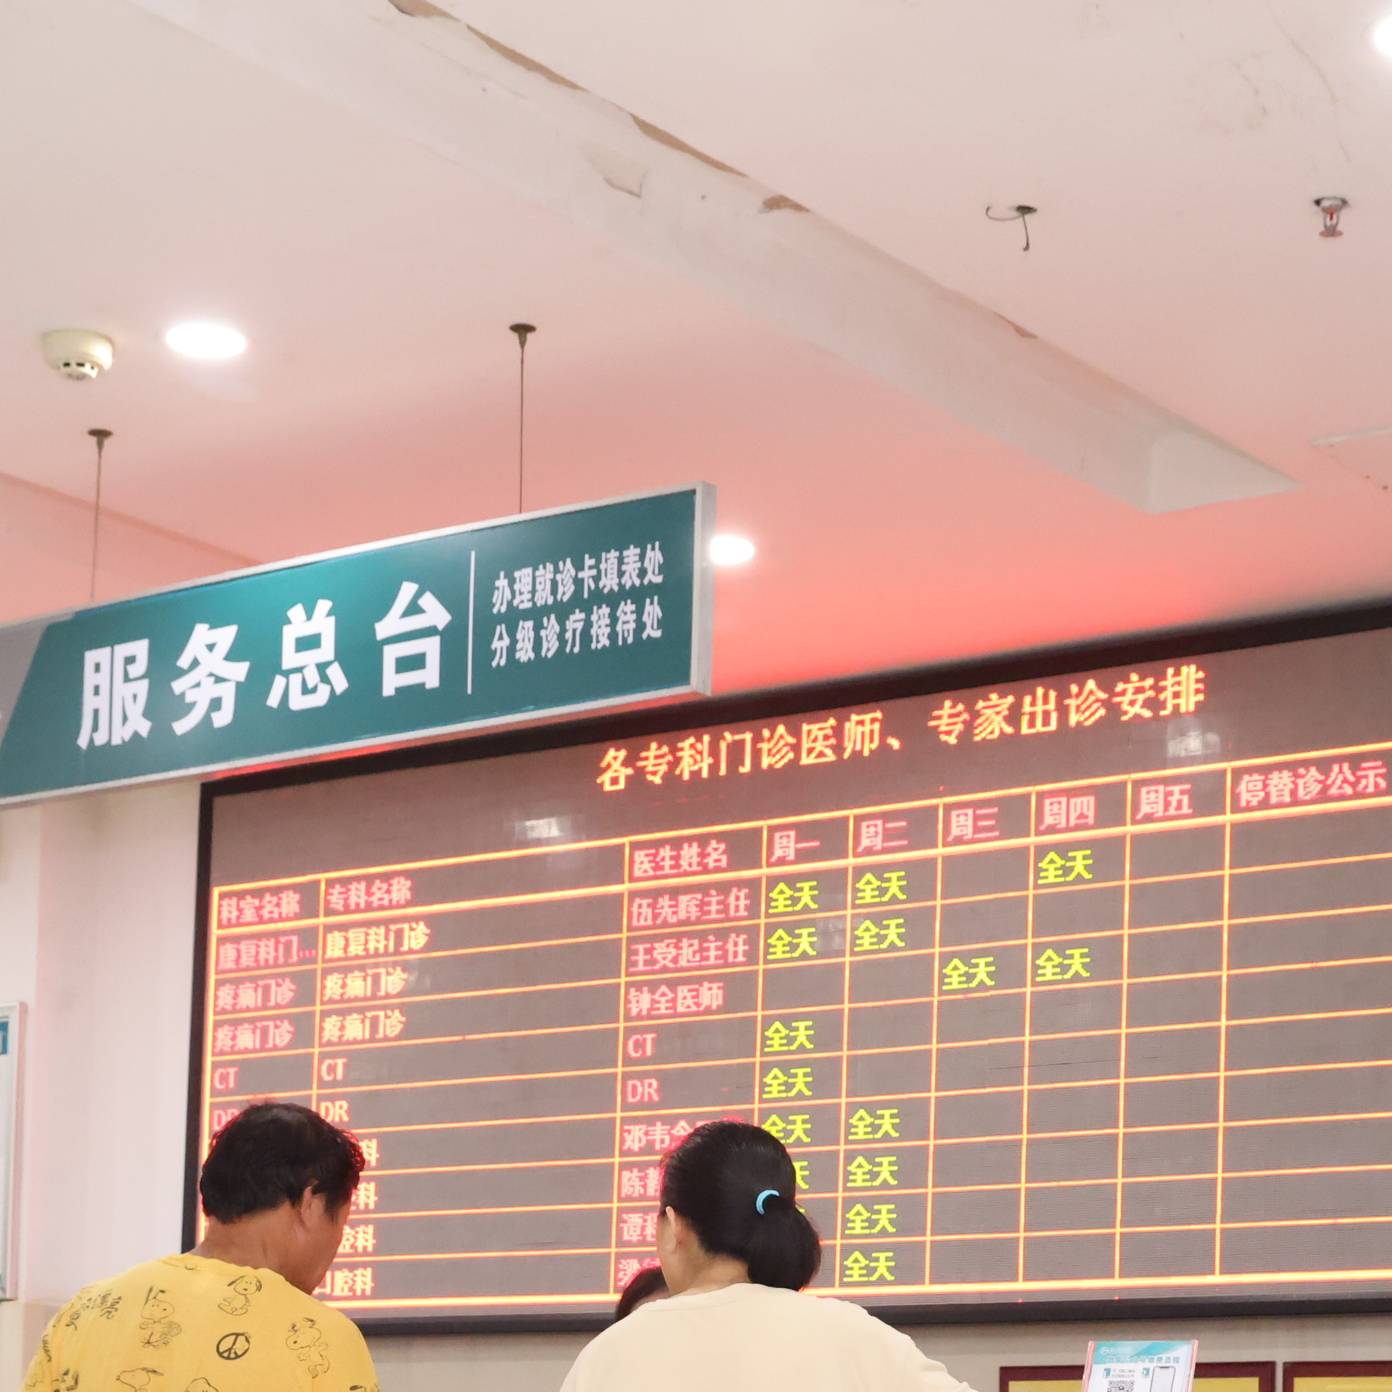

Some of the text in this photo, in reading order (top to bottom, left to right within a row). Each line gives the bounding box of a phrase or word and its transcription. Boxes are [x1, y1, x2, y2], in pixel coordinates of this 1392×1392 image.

[492, 541, 664, 615] 办理就诊卡填表处
[77, 581, 453, 749] 服务总台
[490, 595, 663, 668] 分级诊疗接待处
[219, 762, 1388, 926] 科室名称 专科名称 医生姓名 周一 周二 周三 周四 周五 停替诊公示
[324, 921, 432, 960] 康复科门诊
[768, 880, 820, 914] 全天
[855, 871, 908, 905] 全天
[1037, 849, 1094, 885] 全天
[213, 947, 1091, 1054] 疼痛门诊 疼痛门诊 钟全医师 全天 全天
[215, 978, 297, 1012] 疼痛门诊
[322, 966, 408, 1002] 疼痛门诊
[766, 927, 818, 961] 全天
[853, 918, 906, 952] 全天
[214, 1020, 815, 1090] CT CT CT 全天
[320, 1100, 349, 1123] DR
[626, 1079, 660, 1104] DR
[762, 1067, 814, 1100] 全天
[761, 1114, 812, 1144] 全天
[848, 1107, 901, 1141] 全天
[846, 1154, 899, 1188] 全天
[845, 1203, 898, 1237] 全天
[842, 1249, 896, 1284] 全天
